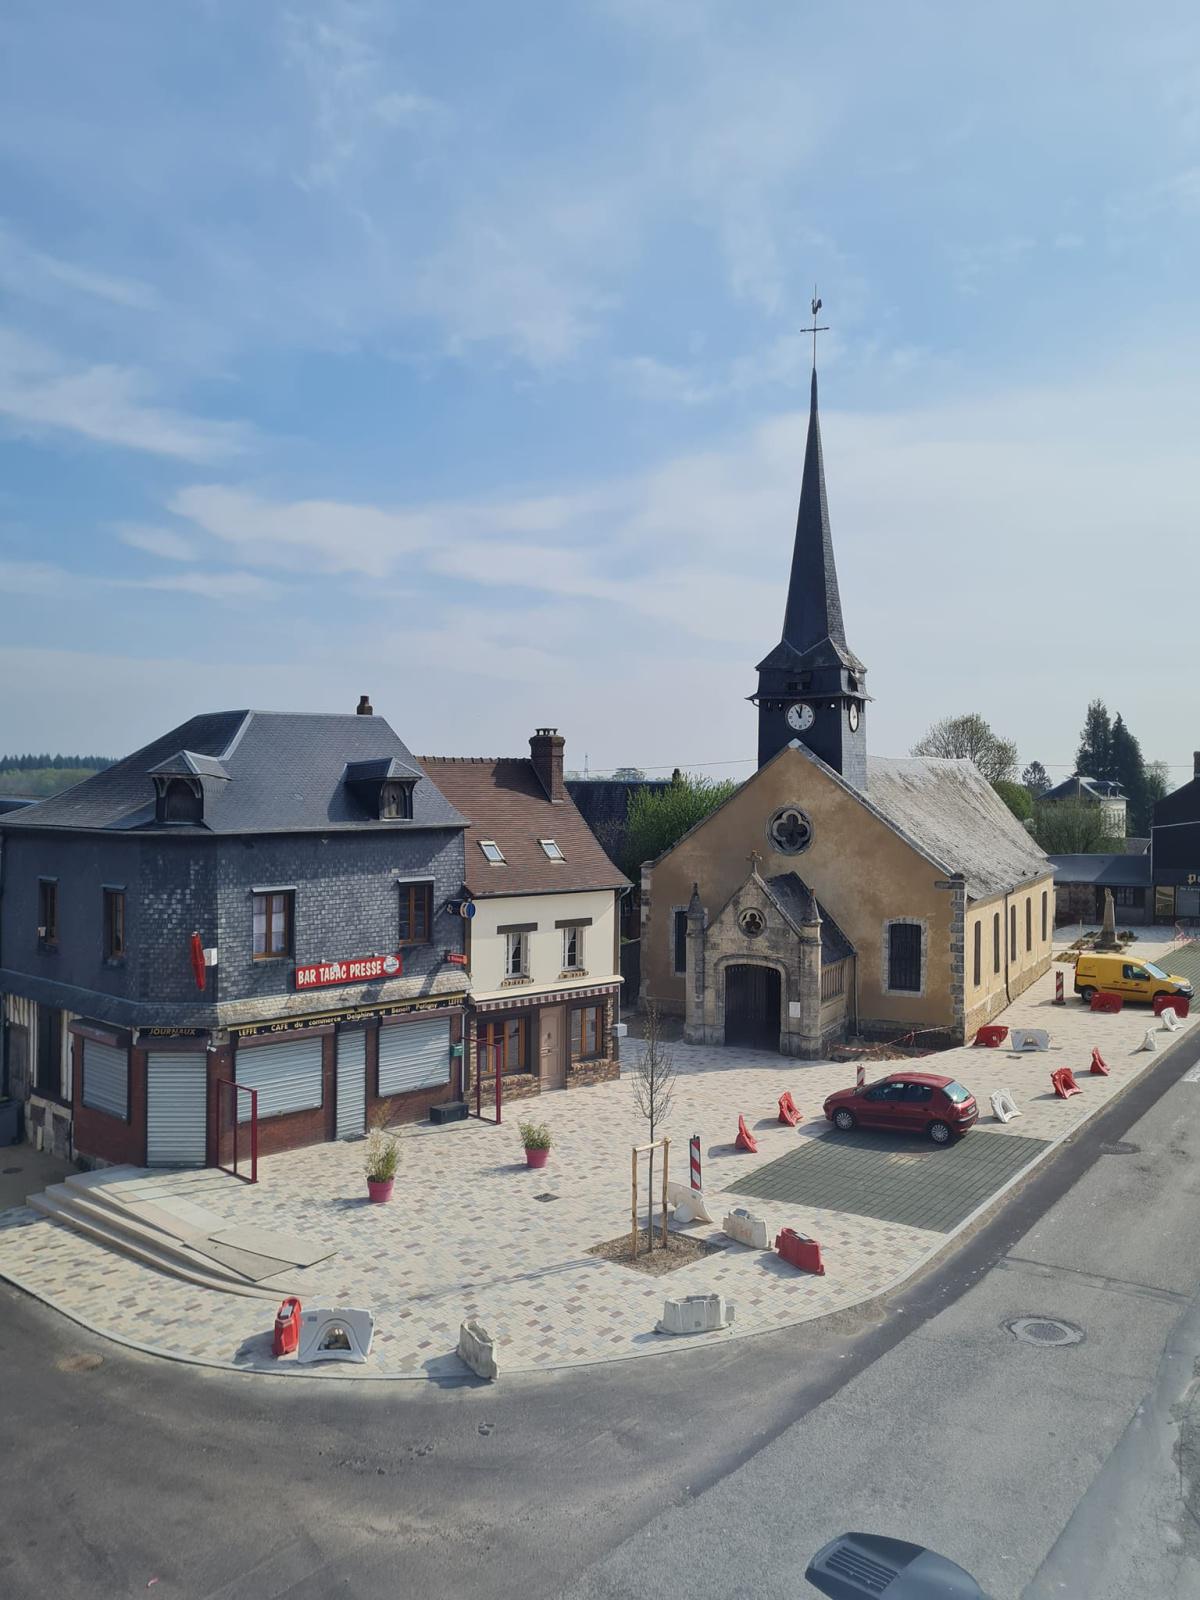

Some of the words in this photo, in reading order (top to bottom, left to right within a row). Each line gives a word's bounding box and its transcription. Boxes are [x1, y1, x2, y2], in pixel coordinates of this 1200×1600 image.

[298, 969, 317, 985] BAR
[319, 963, 347, 983] TABAC
[349, 960, 382, 978] PRESSE
[149, 1027, 196, 1037] JOURNAUX
[238, 1027, 257, 1037] LEFFE
[308, 1016, 342, 1026] commerce
[346, 1011, 375, 1020] Delphine
